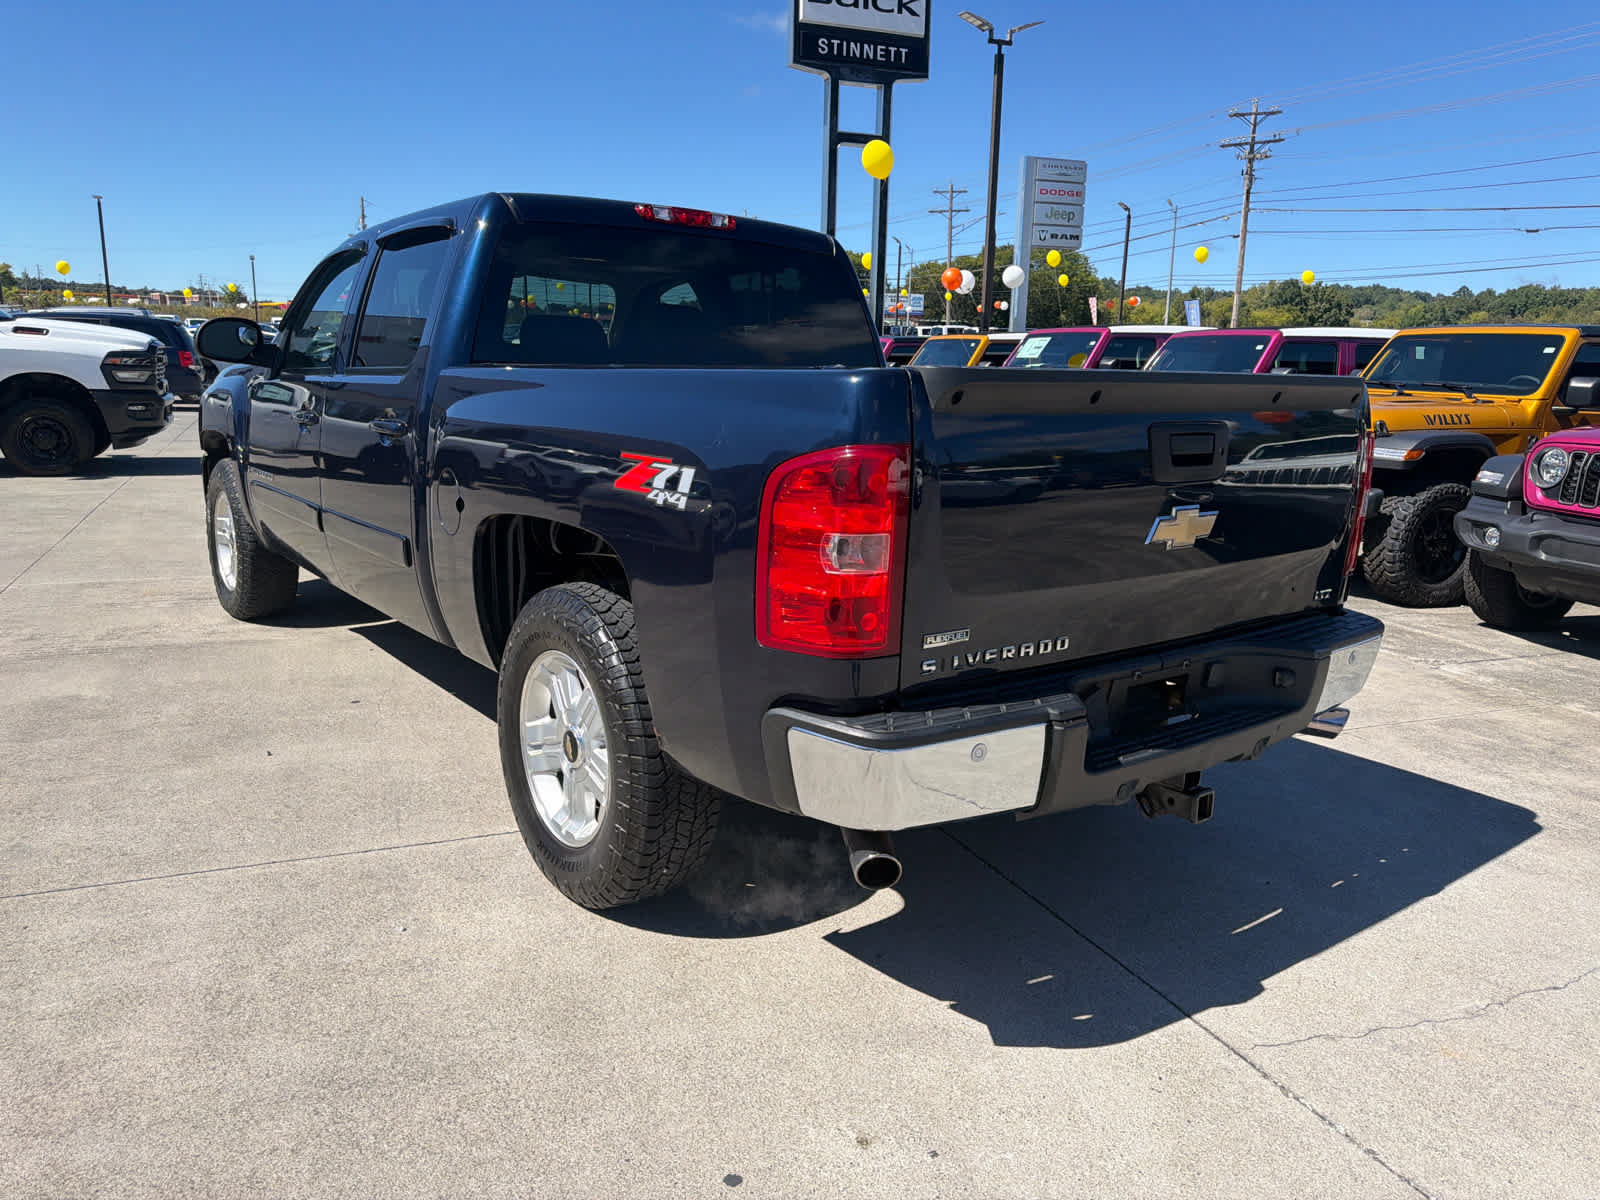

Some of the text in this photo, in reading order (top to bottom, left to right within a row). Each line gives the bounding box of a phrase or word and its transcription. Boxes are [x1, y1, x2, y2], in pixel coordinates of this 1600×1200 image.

[818, 38, 909, 64] STINNETT
[1040, 188, 1083, 197] DODGE
[1045, 207, 1076, 223] Jeep
[1050, 232, 1080, 241] RAM
[1424, 414, 1472, 425] WILLYS
[614, 452, 696, 494] Z71
[921, 636, 1070, 675] SILVERADO
